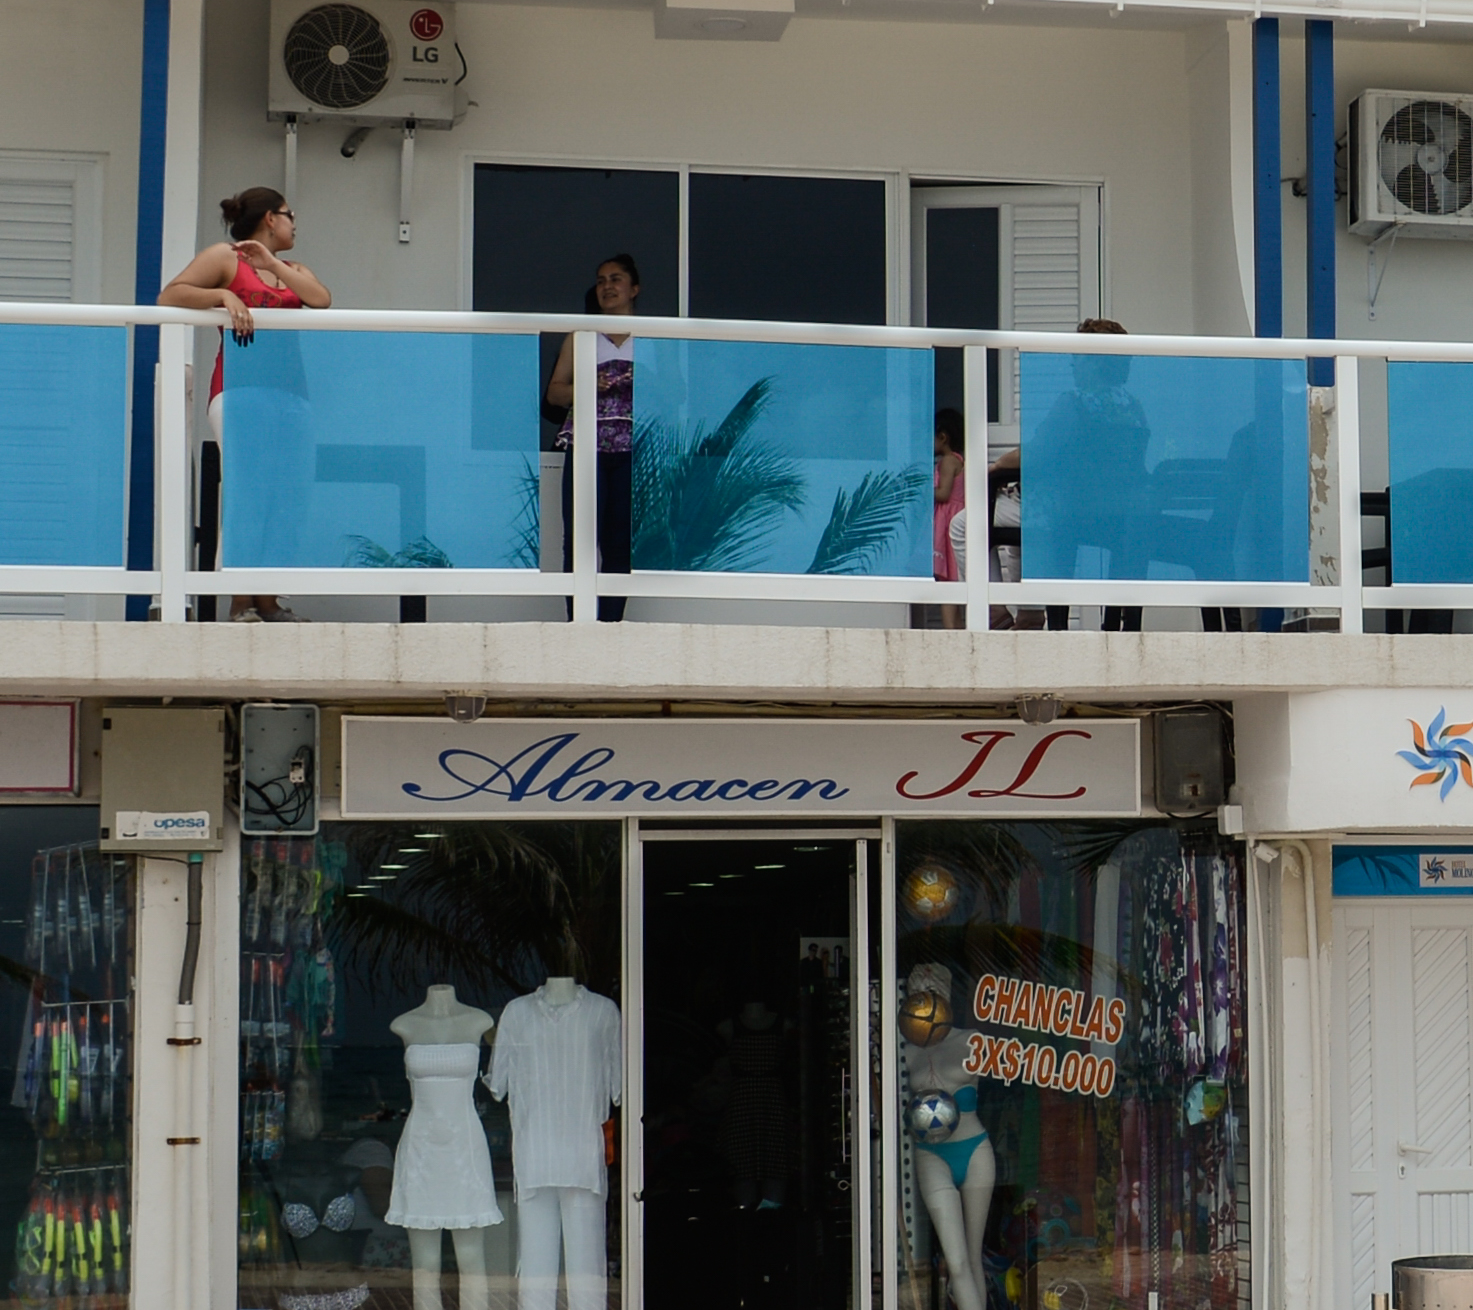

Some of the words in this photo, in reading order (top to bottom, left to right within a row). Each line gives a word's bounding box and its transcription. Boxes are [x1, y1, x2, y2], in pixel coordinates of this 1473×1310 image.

[412, 46, 438, 63] LG
[402, 733, 849, 802] Almacen
[1451, 860, 1466, 868] HOTEL
[974, 973, 1126, 1045] CHANCLAS
[962, 1032, 1115, 1098] 3X$10.000
